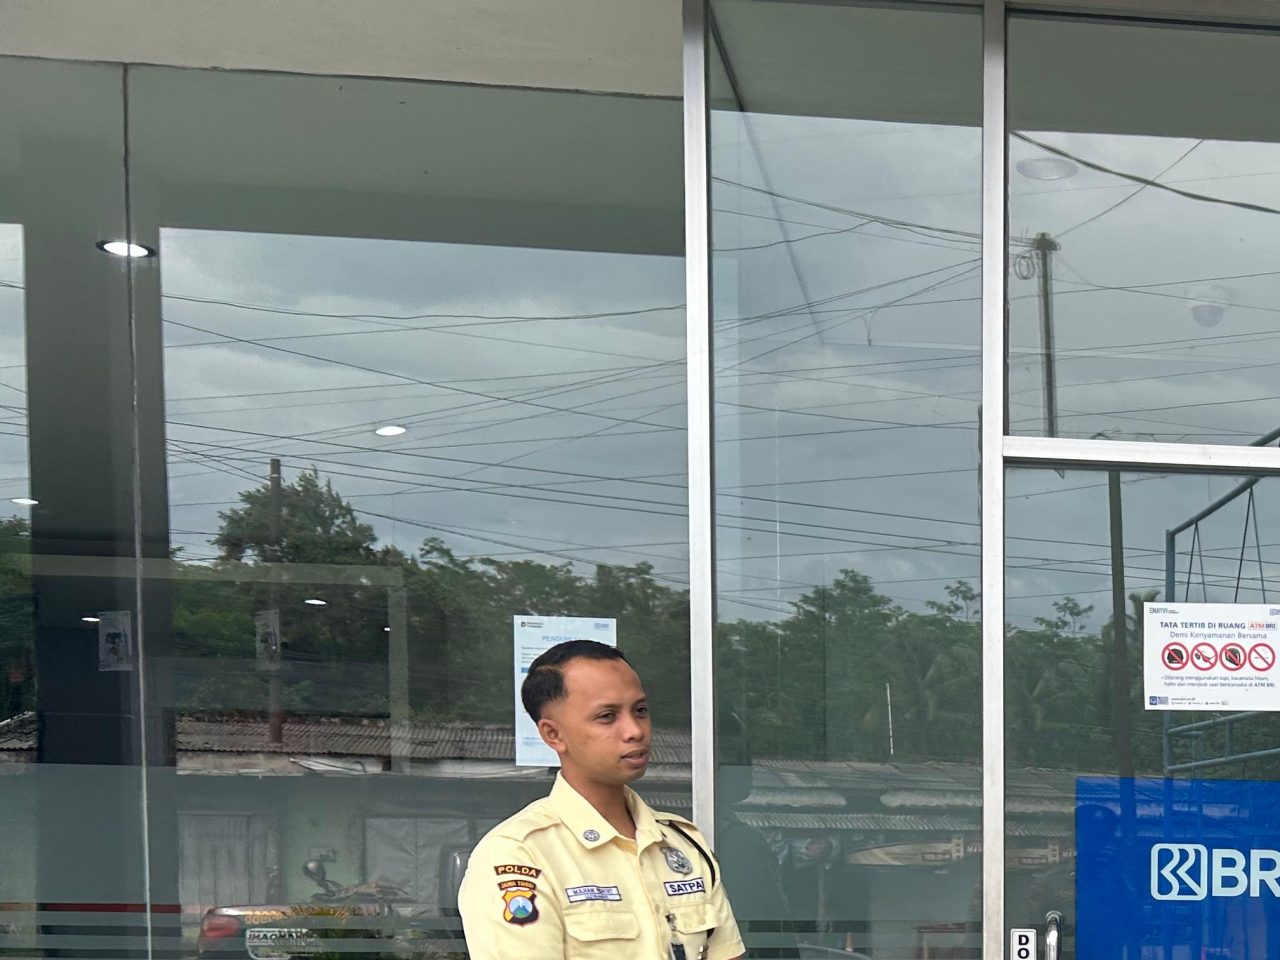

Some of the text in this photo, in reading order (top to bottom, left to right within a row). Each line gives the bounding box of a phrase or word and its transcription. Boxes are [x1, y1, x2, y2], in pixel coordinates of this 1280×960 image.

[1190, 631, 1236, 640] Kenyamanan
[498, 865, 537, 877] POLDA
[669, 880, 705, 893] SATPA
